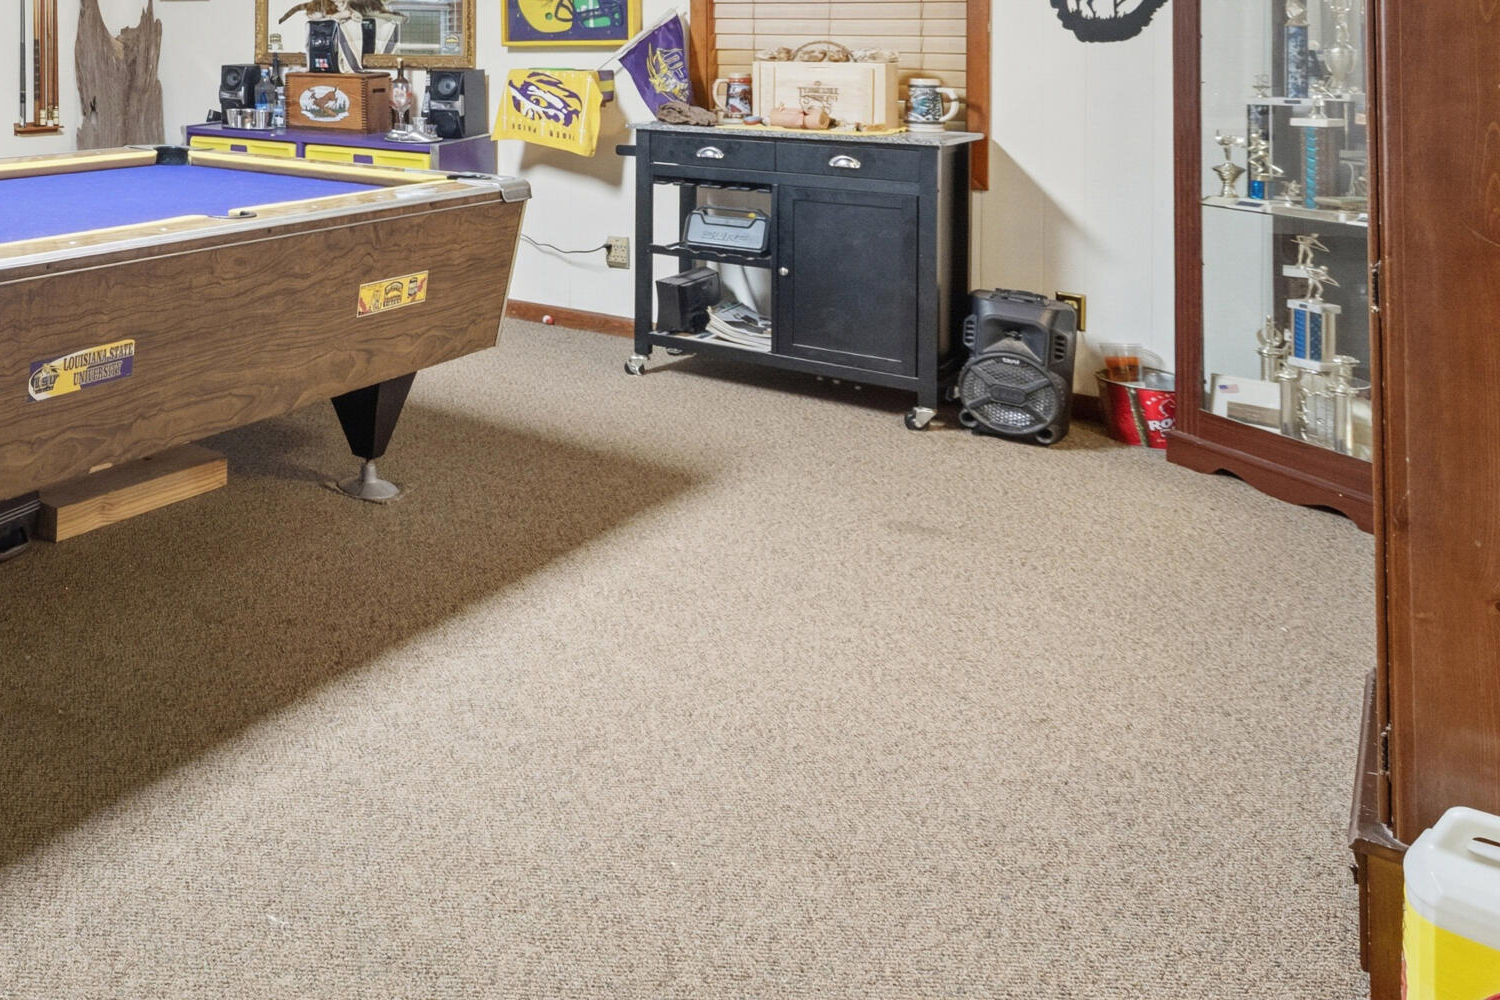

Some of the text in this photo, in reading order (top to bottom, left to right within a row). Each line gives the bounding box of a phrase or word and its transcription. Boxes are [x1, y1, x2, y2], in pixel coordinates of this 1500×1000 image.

[63, 343, 134, 371] LOUISIANA STATE
[73, 361, 123, 385] UNIVERSITY
[1148, 418, 1176, 431] RO
